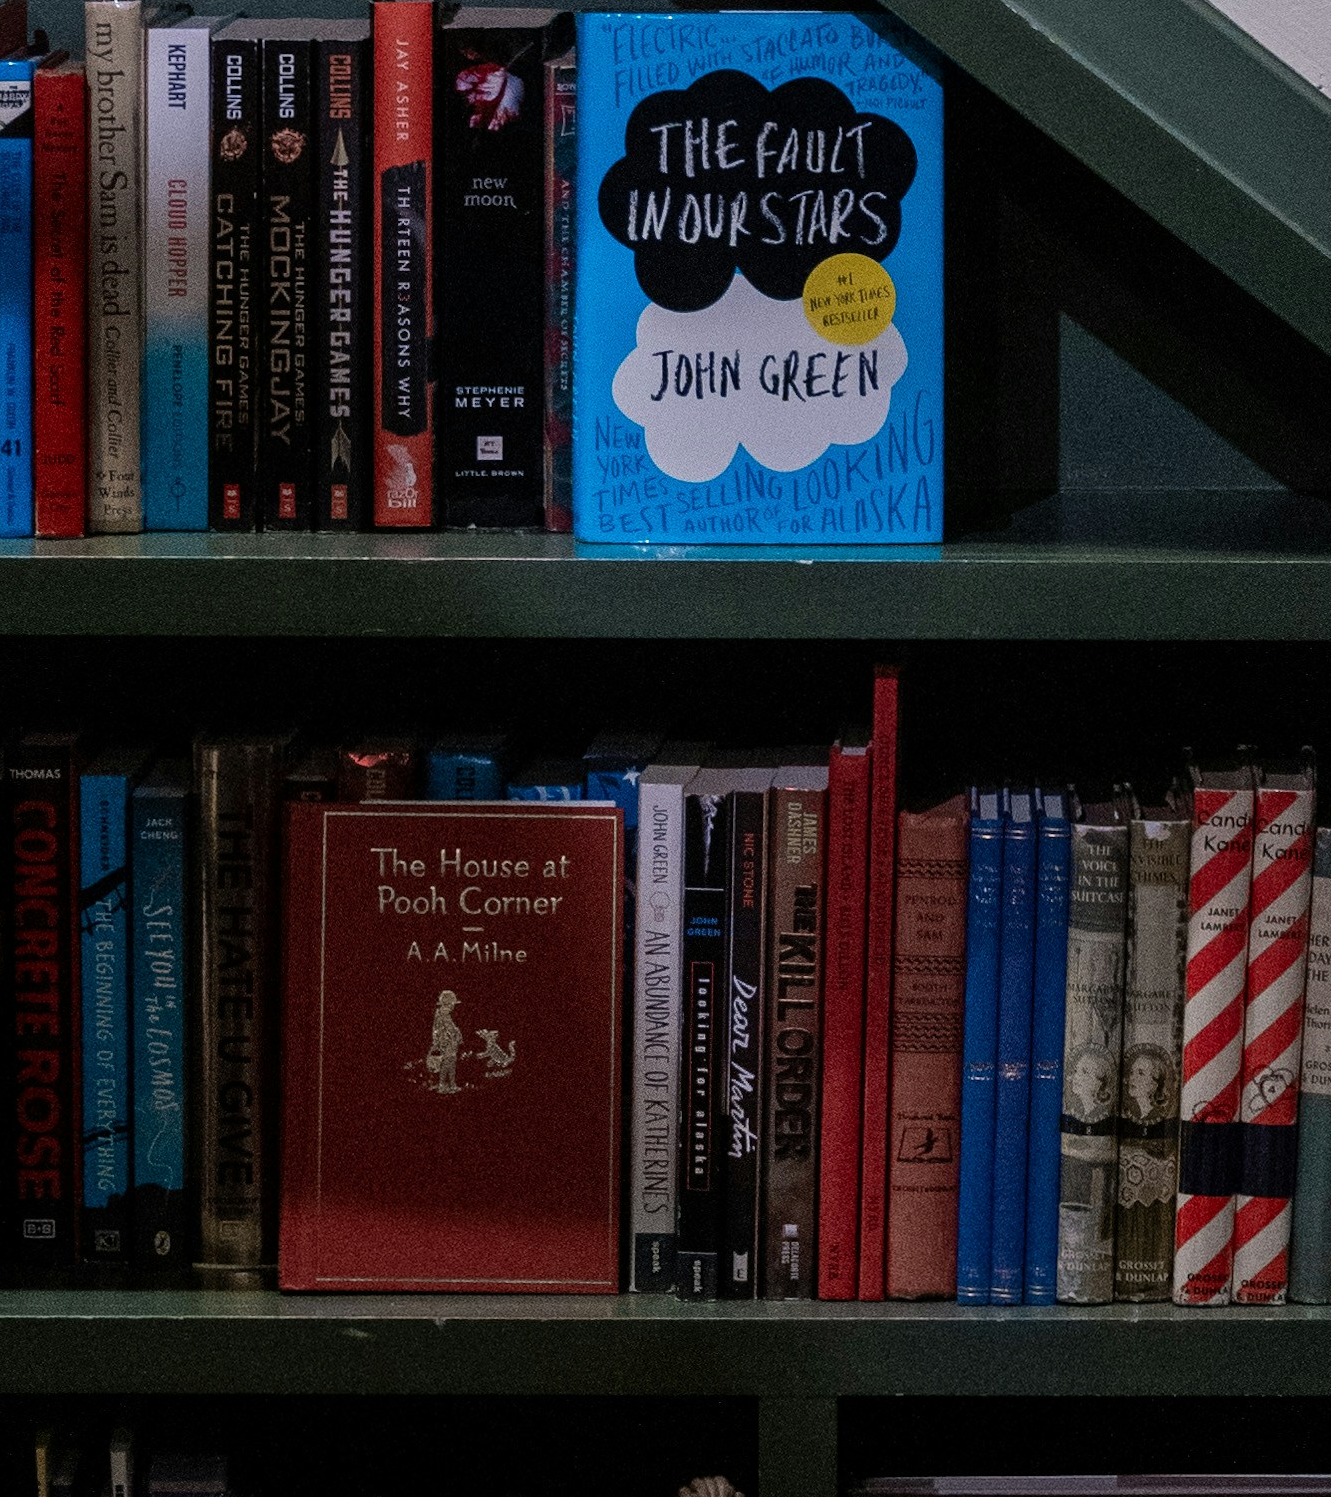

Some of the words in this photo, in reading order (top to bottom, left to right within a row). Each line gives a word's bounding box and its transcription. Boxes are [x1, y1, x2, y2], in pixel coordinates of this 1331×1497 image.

[88, 21, 113, 65] my
[95, 69, 126, 166] brother
[649, 118, 745, 178] THE
[757, 121, 872, 179] FAULT
[98, 170, 128, 227] Sam
[333, 165, 349, 201] THE
[463, 193, 516, 208] moon
[472, 177, 507, 190] new
[100, 234, 129, 253] is
[627, 187, 670, 241] IN
[678, 191, 751, 246] OUR
[760, 189, 887, 246] STARS
[101, 258, 130, 317] dead
[329, 209, 351, 323] HUNGER
[269, 194, 291, 446] MOCKINGJAY
[329, 330, 351, 418] GAMES
[456, 386, 525, 395] STEPHENIE
[651, 350, 741, 401] JOHN
[759, 350, 879, 403] GREEN
[455, 396, 525, 408] MEYER
[370, 848, 426, 878] The
[440, 848, 529, 878] House
[543, 855, 570, 878] at
[13, 800, 61, 1038] CONCRETE
[378, 885, 447, 915] Pooh
[459, 886, 563, 915] Corner
[15, 1049, 63, 1200] ROSE
